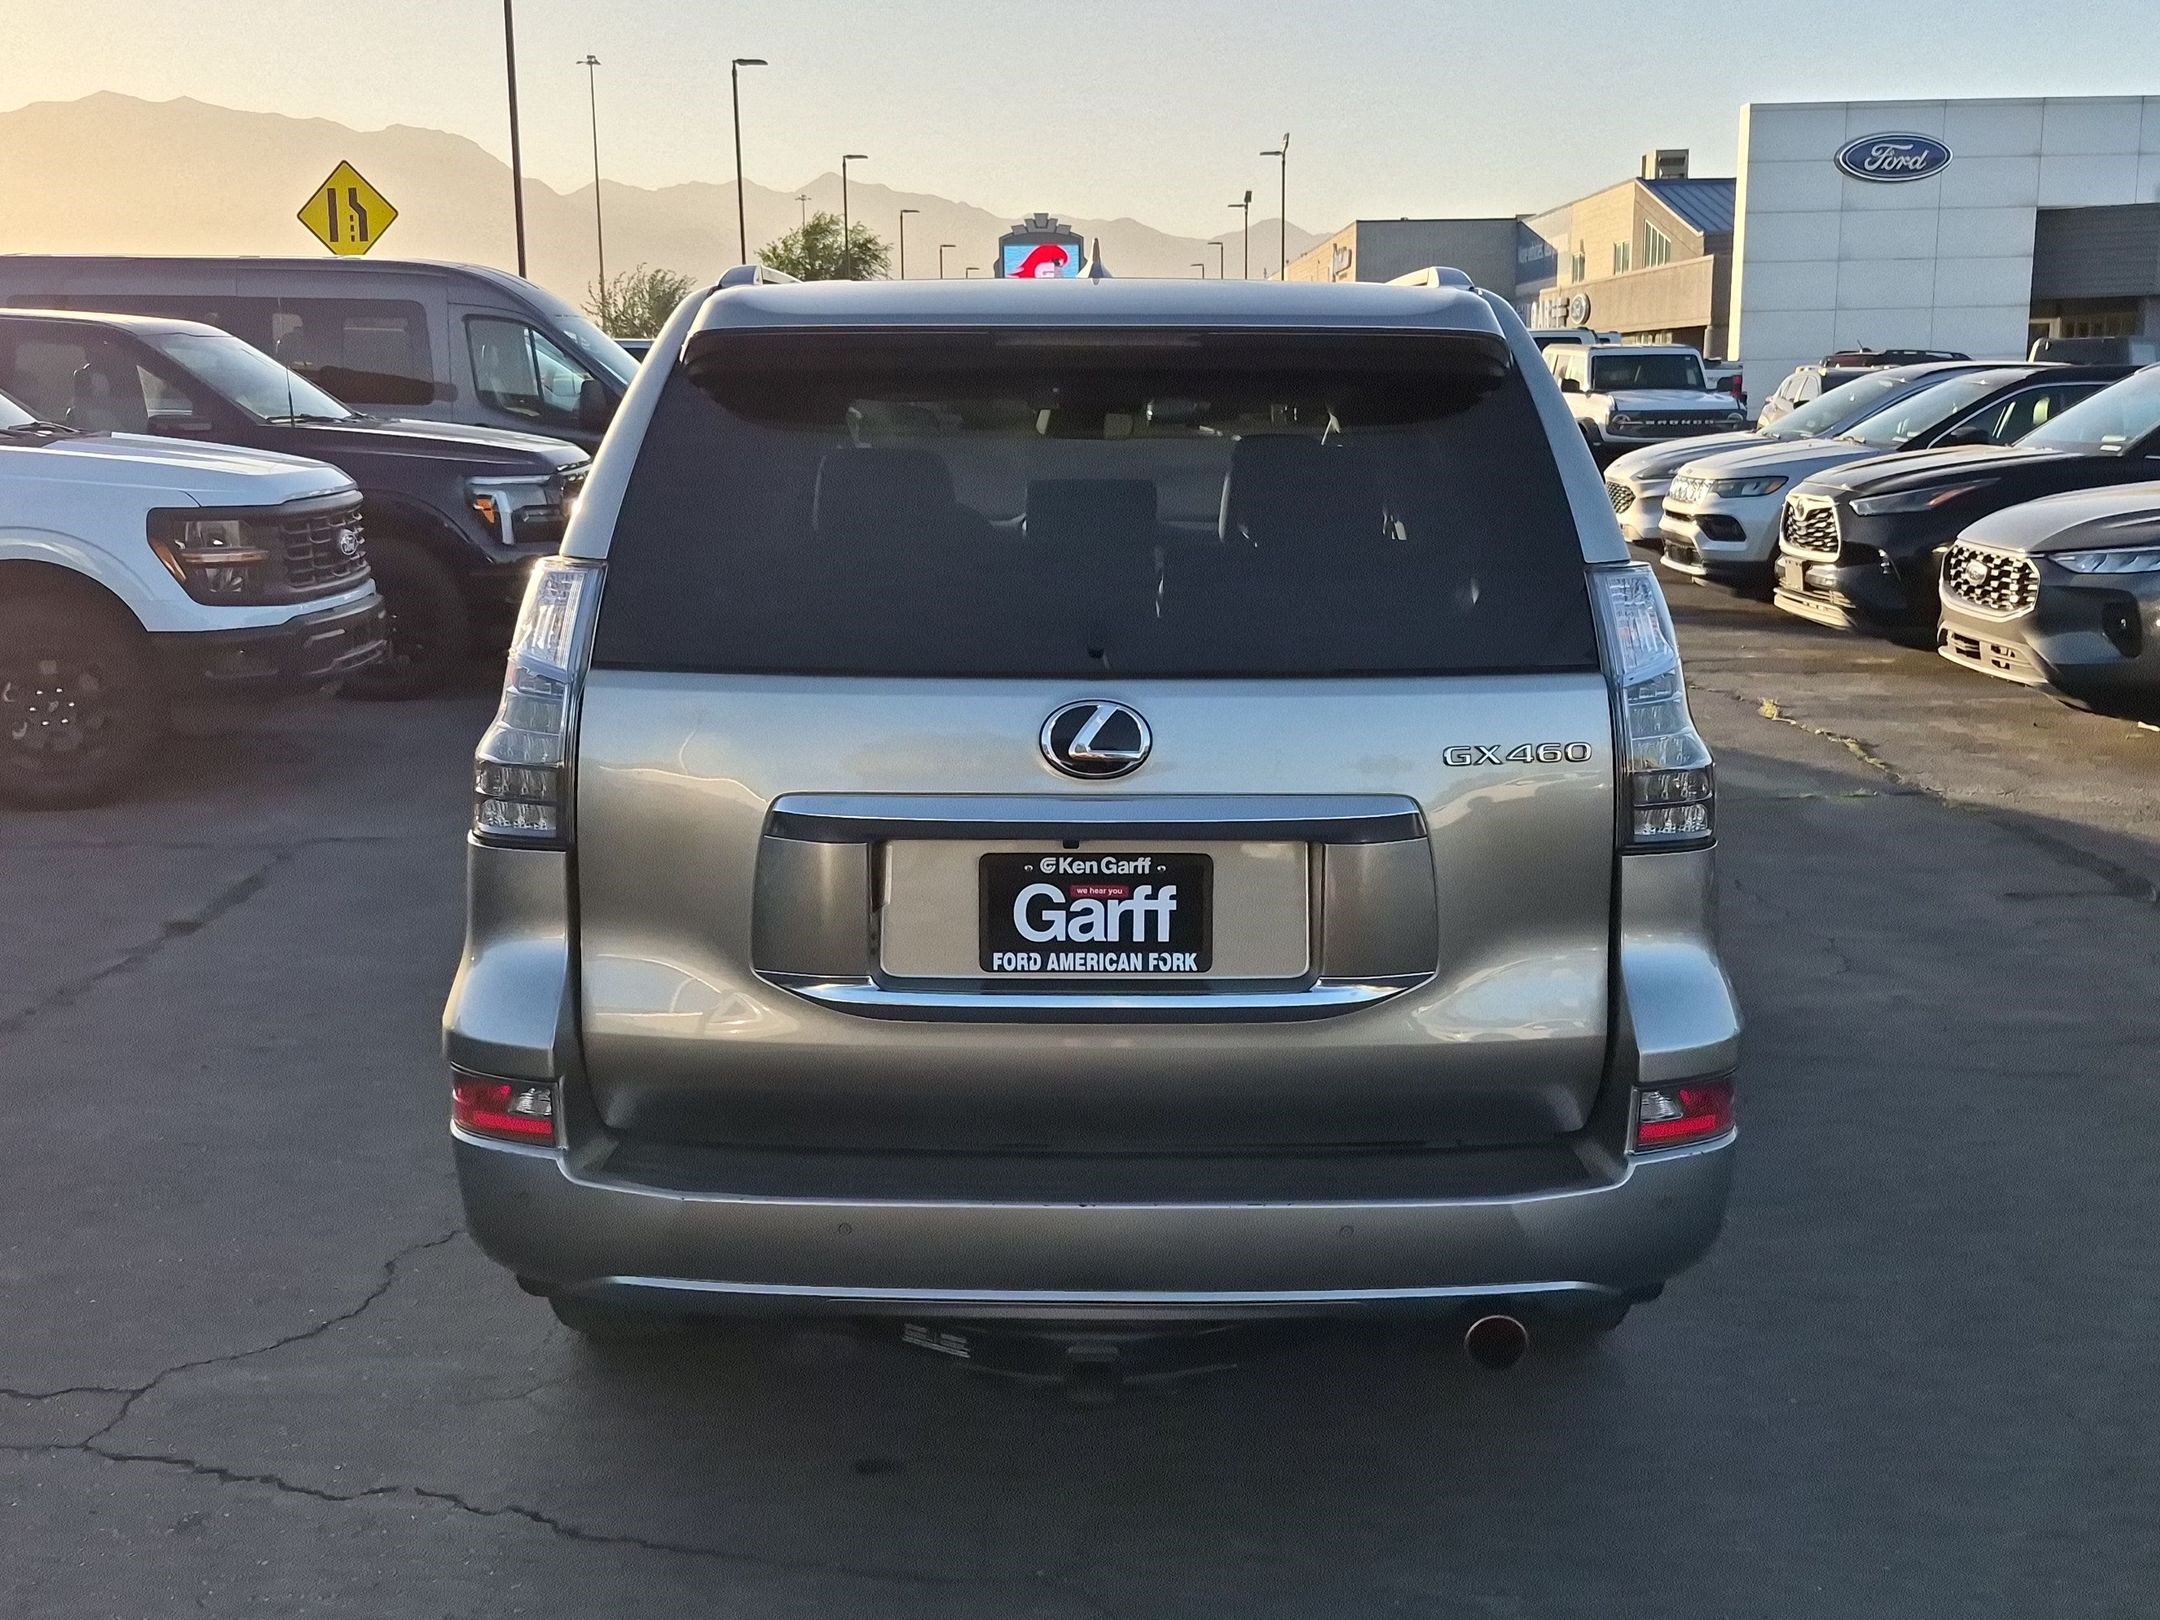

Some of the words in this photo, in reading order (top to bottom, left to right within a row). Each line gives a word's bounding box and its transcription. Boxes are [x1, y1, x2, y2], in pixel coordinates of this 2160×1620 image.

[1864, 143, 1930, 171] Ford
[1058, 857, 1098, 874] Ken
[1100, 857, 1151, 874] Garff
[1089, 887, 1106, 895] hear
[1107, 888, 1123, 897] you
[1013, 883, 1177, 943] Garff
[992, 952, 1042, 971] FORD
[1047, 952, 1143, 971] AMERICAN
[1149, 952, 1198, 971] FORK
